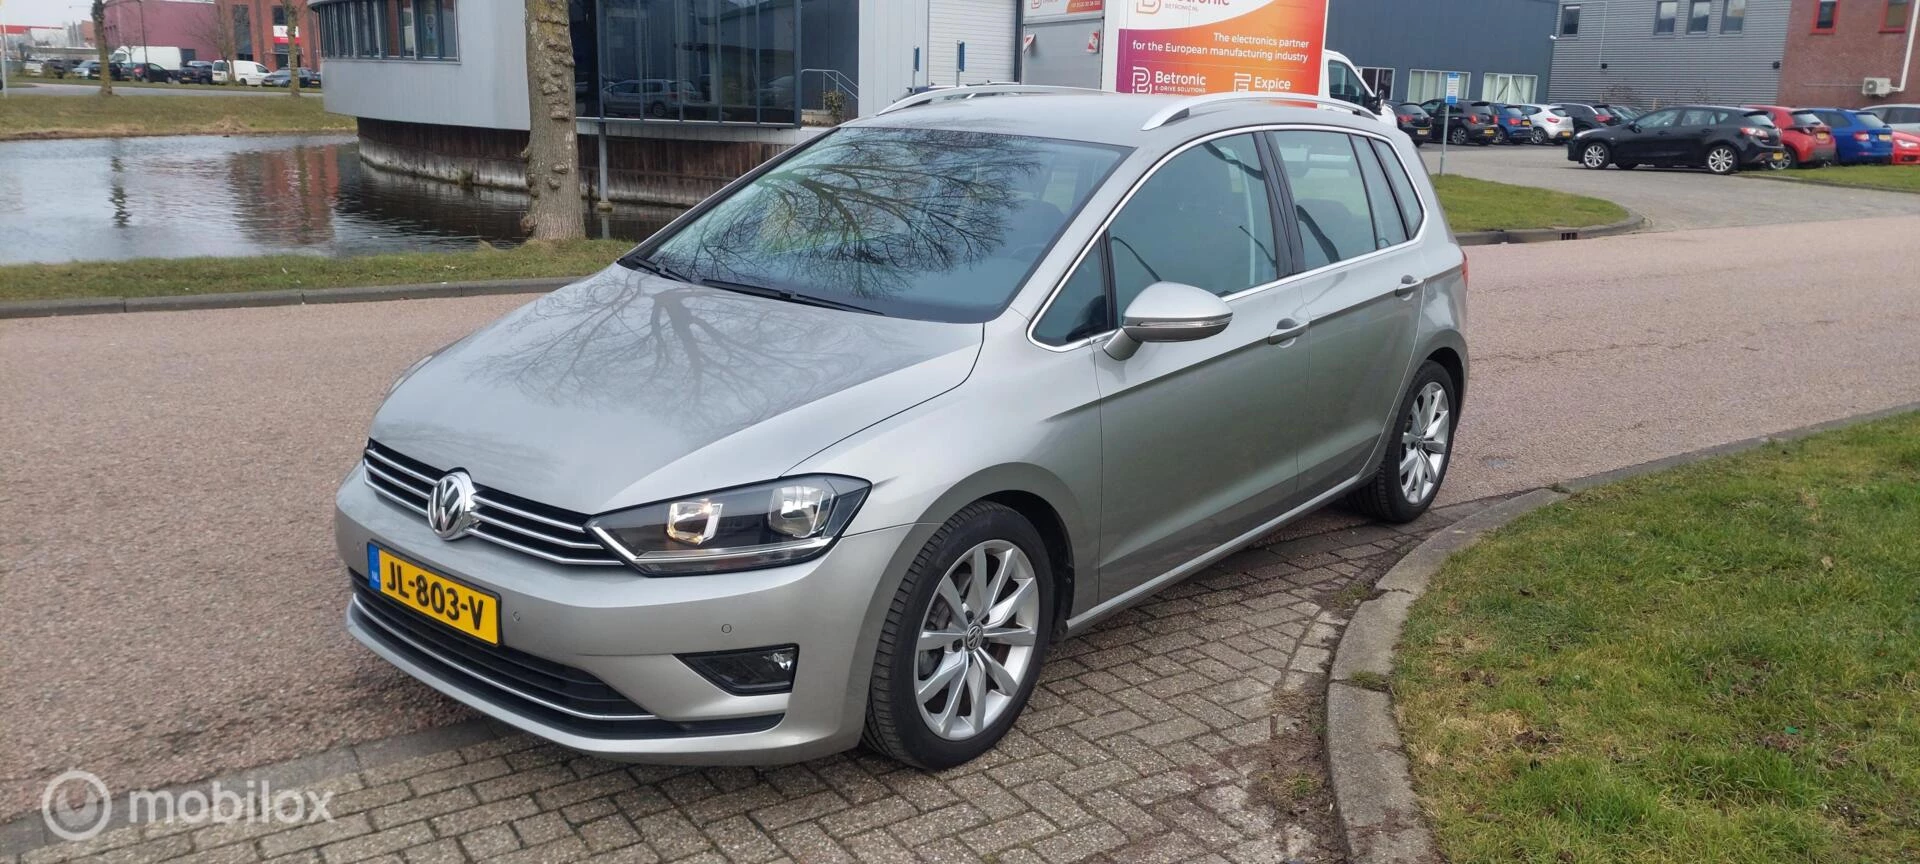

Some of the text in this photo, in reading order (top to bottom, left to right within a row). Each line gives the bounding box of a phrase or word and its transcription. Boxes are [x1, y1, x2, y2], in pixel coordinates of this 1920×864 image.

[1213, 32, 1310, 48] The electronics partner
[1132, 40, 1309, 64] for the European manufacturing industry
[1155, 71, 1207, 86] Betronic
[1254, 76, 1291, 92] Expice
[387, 561, 484, 631] JL-803-V
